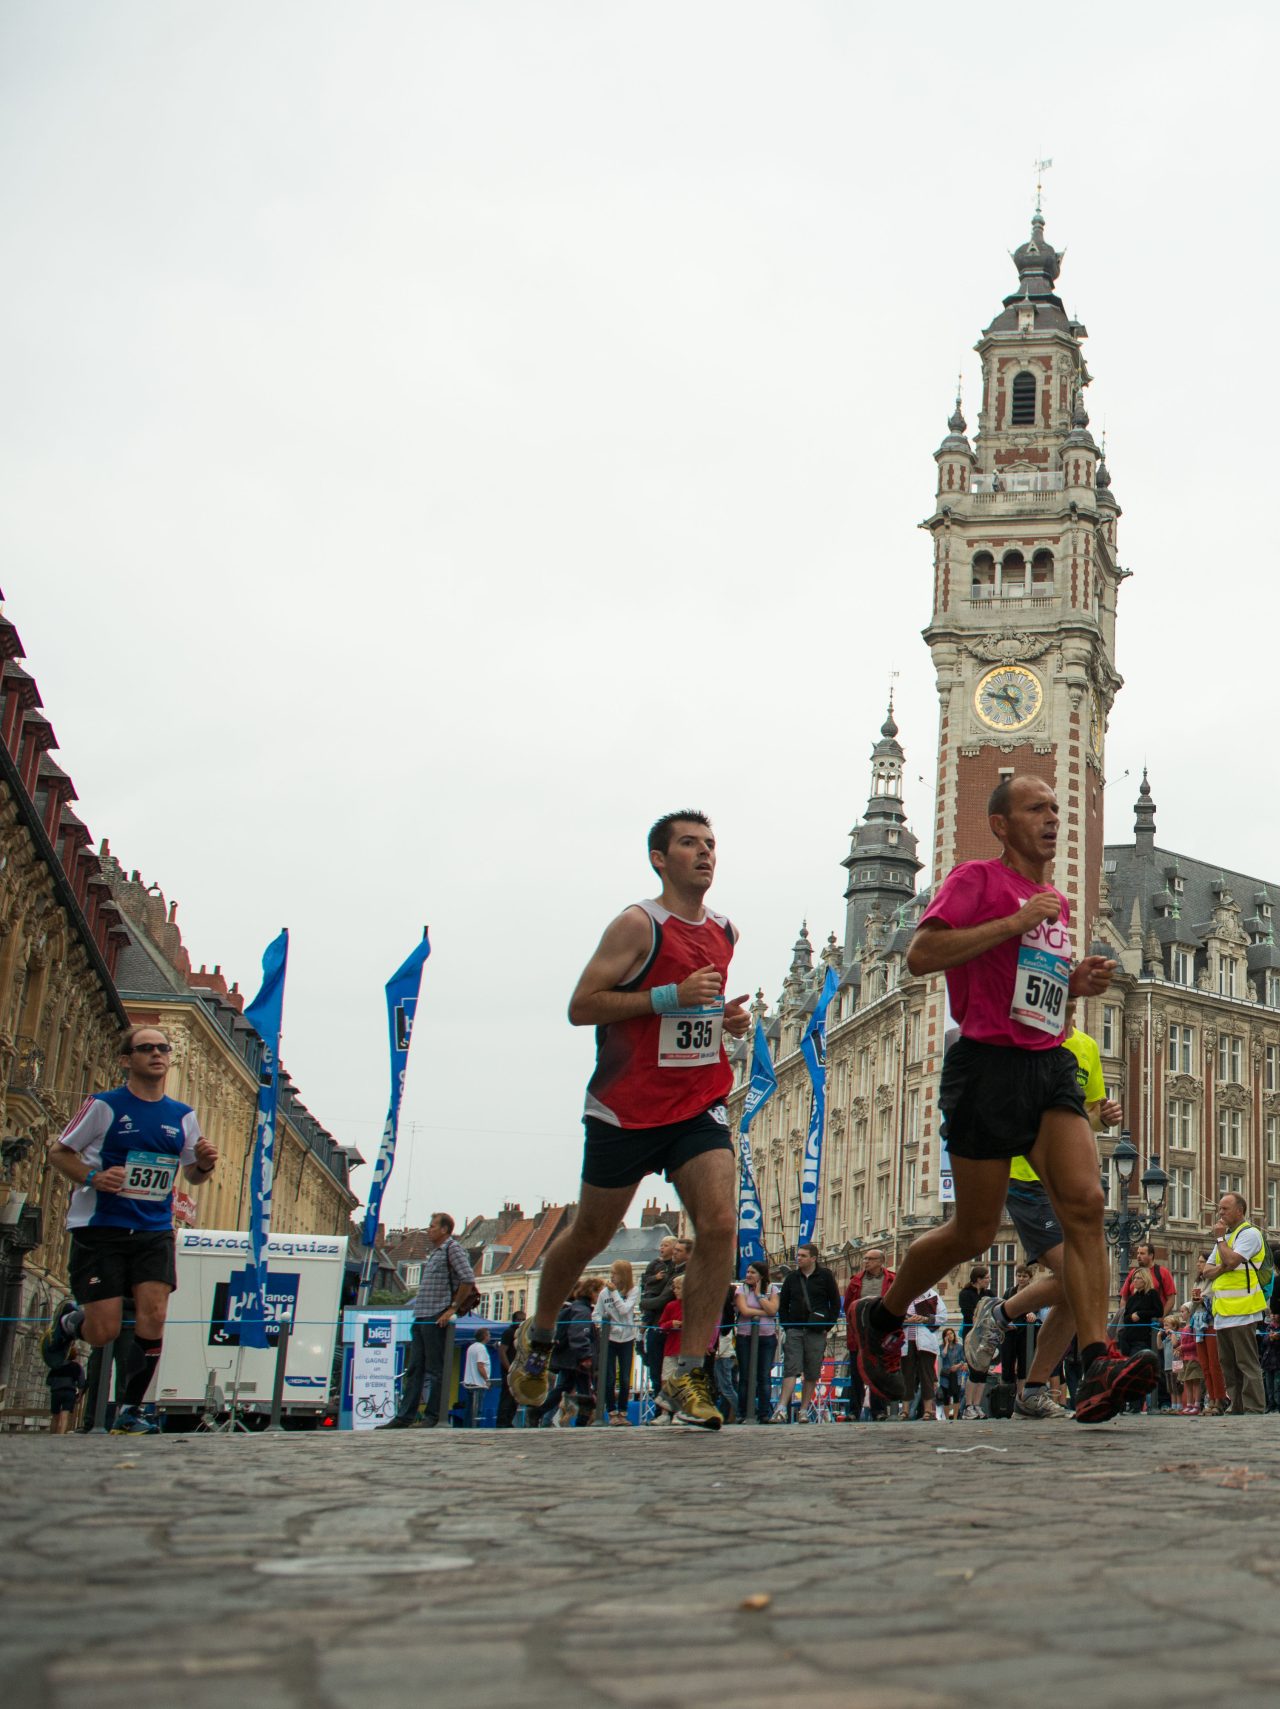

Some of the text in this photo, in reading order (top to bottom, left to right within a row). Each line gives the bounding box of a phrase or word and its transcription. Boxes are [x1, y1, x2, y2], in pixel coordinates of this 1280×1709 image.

[1025, 974, 1064, 1017] 5749
[676, 1020, 713, 1049] 335
[129, 1167, 170, 1190] 5370
[228, 1295, 294, 1322] beu
[368, 1327, 391, 1339] bleu
